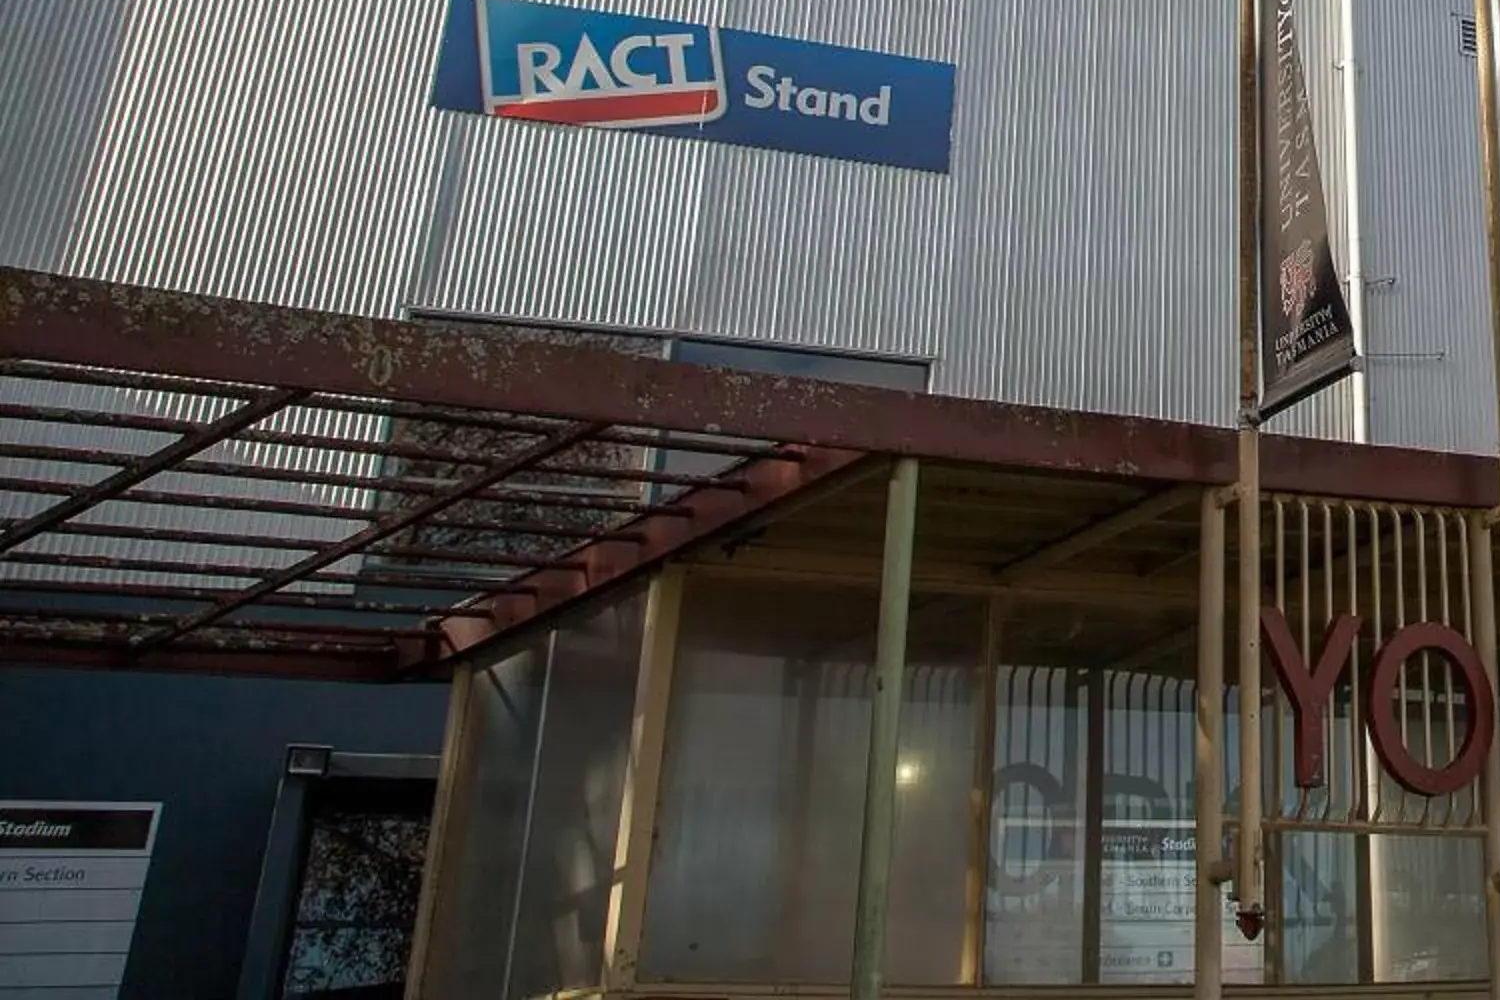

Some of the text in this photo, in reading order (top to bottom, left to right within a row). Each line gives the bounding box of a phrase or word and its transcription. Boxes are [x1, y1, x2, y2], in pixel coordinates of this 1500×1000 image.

[516, 31, 694, 96] RACT
[744, 65, 892, 126] Stand
[0, 819, 72, 837] Stadium
[23, 866, 86, 883] Section
